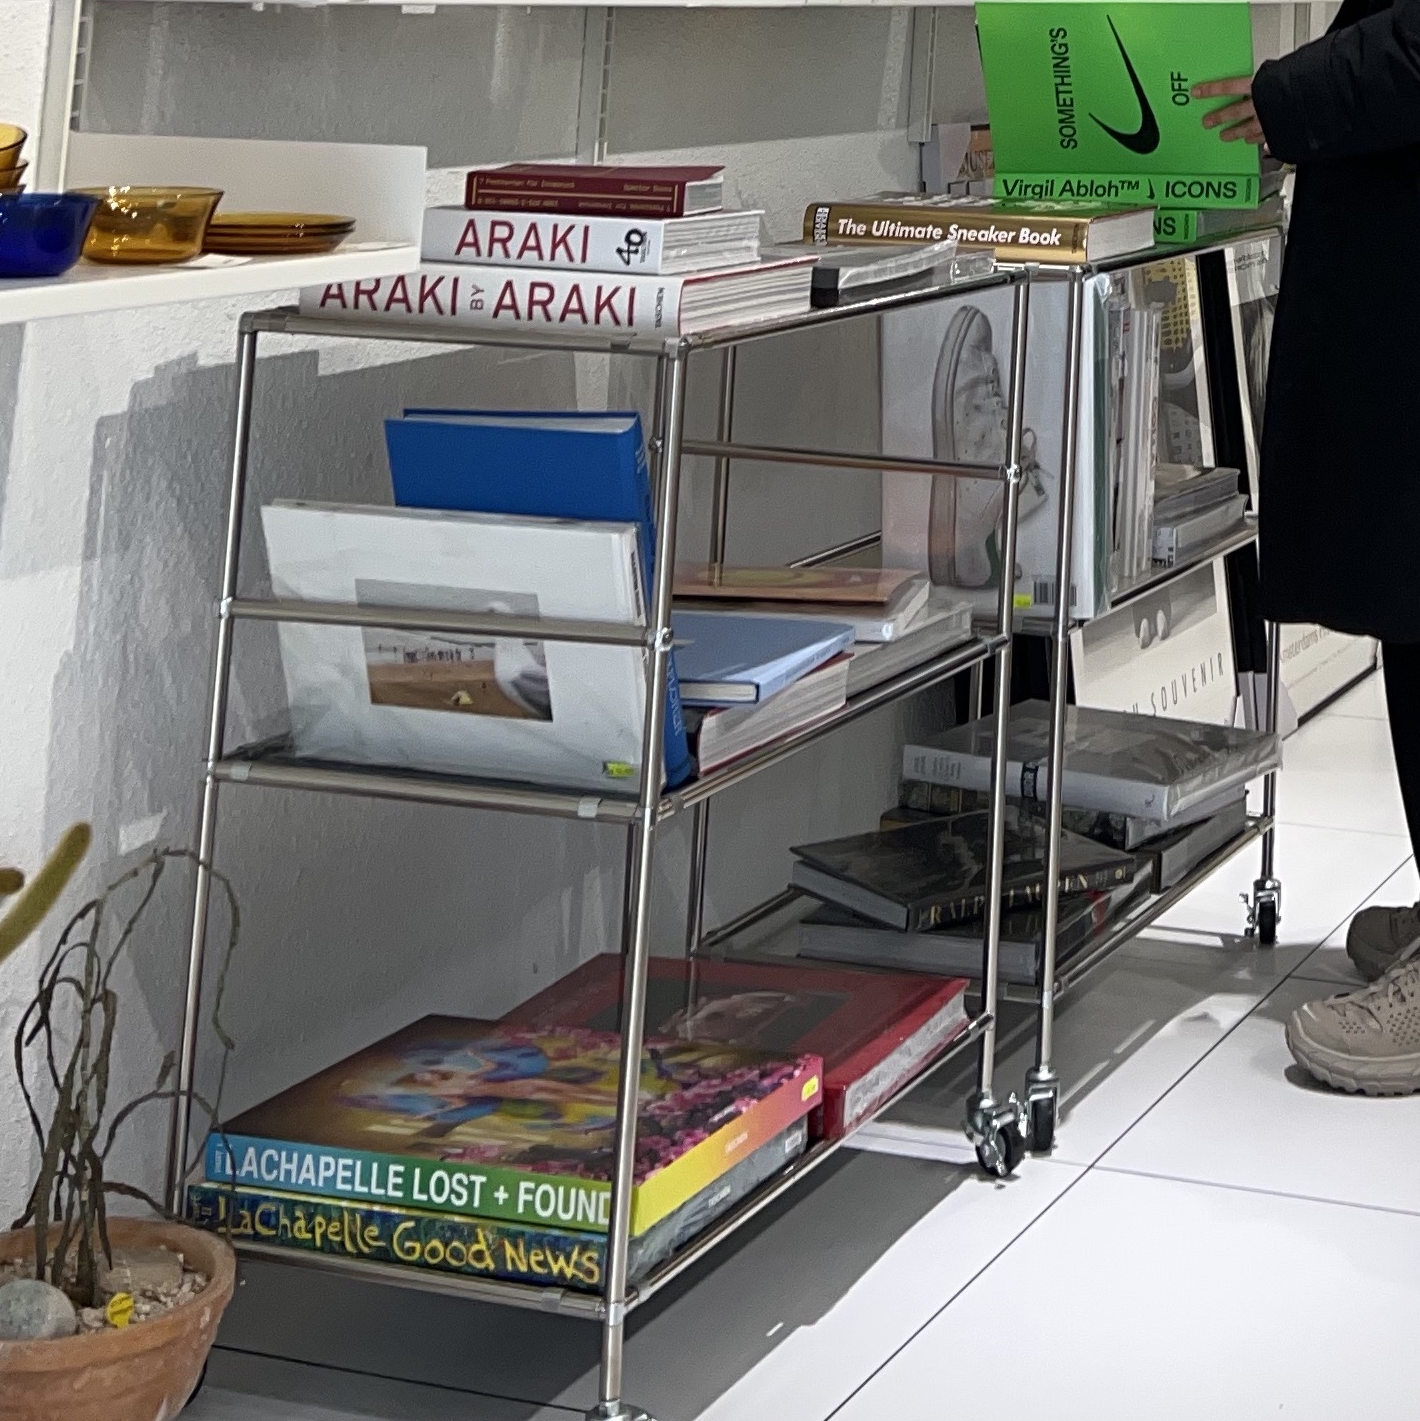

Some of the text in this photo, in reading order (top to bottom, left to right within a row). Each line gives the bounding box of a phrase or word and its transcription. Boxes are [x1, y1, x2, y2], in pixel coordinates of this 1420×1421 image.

[1049, 27, 1078, 150] SOMETHING'S
[1170, 71, 1190, 106] OFF
[1002, 178, 1054, 200] Virgil
[1164, 180, 1238, 199] ICONS
[455, 218, 590, 263] ARAKI
[837, 219, 867, 236] The
[872, 220, 943, 240] Ultimate
[947, 224, 1016, 245] Sneaker
[1019, 227, 1062, 246] Book
[319, 275, 636, 328] ARAKI BY ARAKI
[1150, 652, 1225, 718] SOUVENIR
[929, 873, 1088, 926] RALP LAUEN
[224, 1145, 405, 1198] LACHAPELLE
[413, 1167, 487, 1208] LOST
[494, 1186, 509, 1205] +
[217, 1194, 387, 1255] LaChapelle
[392, 1220, 495, 1271] Good
